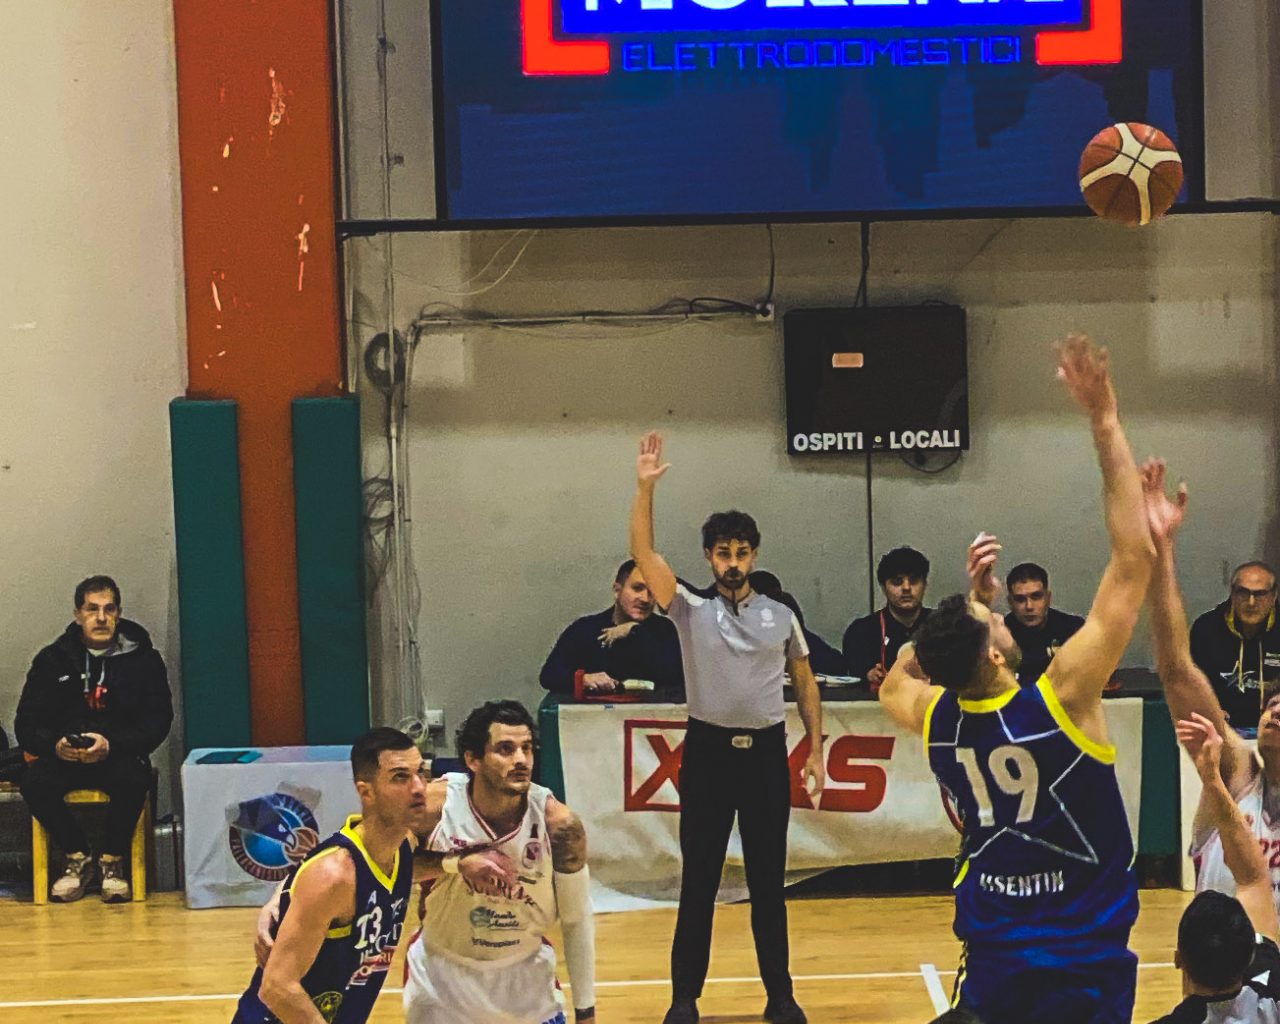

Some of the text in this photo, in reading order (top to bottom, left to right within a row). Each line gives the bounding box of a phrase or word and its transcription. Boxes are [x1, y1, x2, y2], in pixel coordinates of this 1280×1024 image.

[622, 36, 1021, 71] ELETTRODOMESTICI
[793, 429, 960, 451] OSPITI LOCALI
[955, 745, 1039, 827] 19
